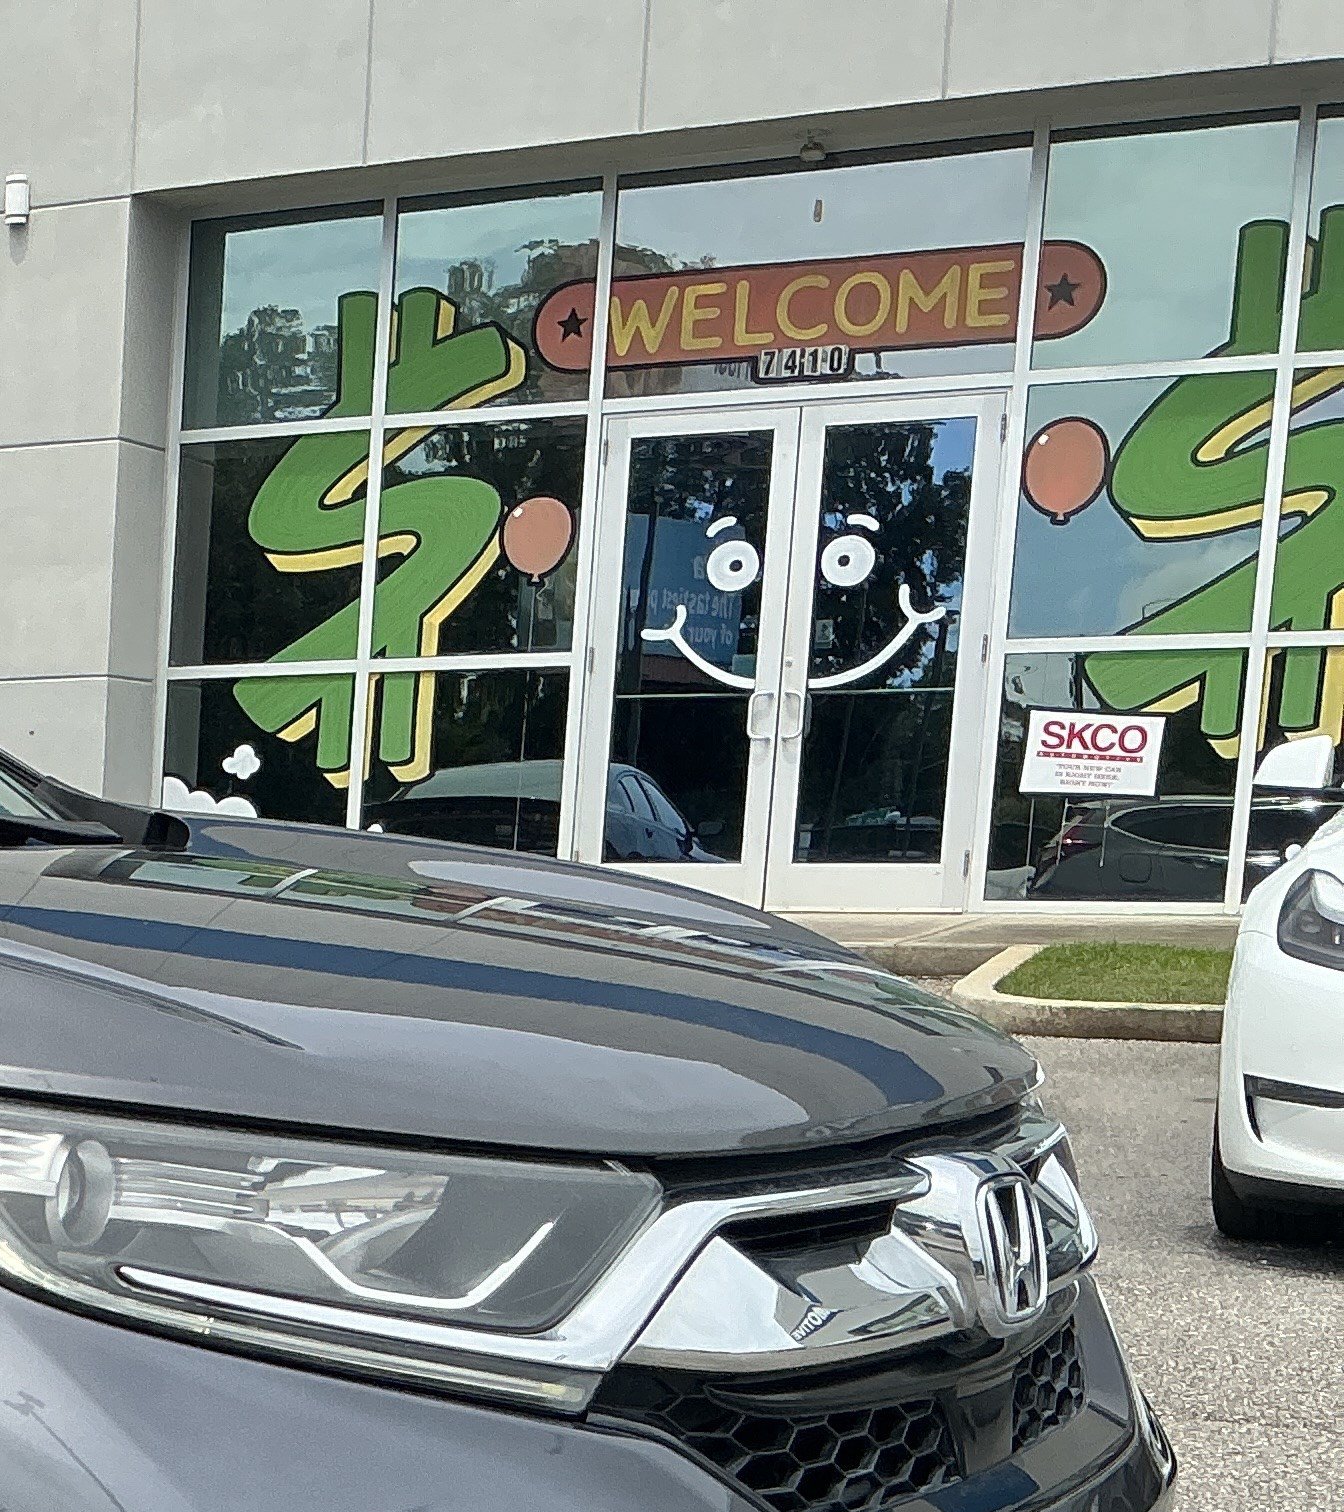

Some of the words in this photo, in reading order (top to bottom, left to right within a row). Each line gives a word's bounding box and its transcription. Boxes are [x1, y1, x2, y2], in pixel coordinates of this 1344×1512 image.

[611, 260, 1015, 356] WELCOME
[762, 346, 843, 377] 7410
[1041, 720, 1148, 754] SKCO
